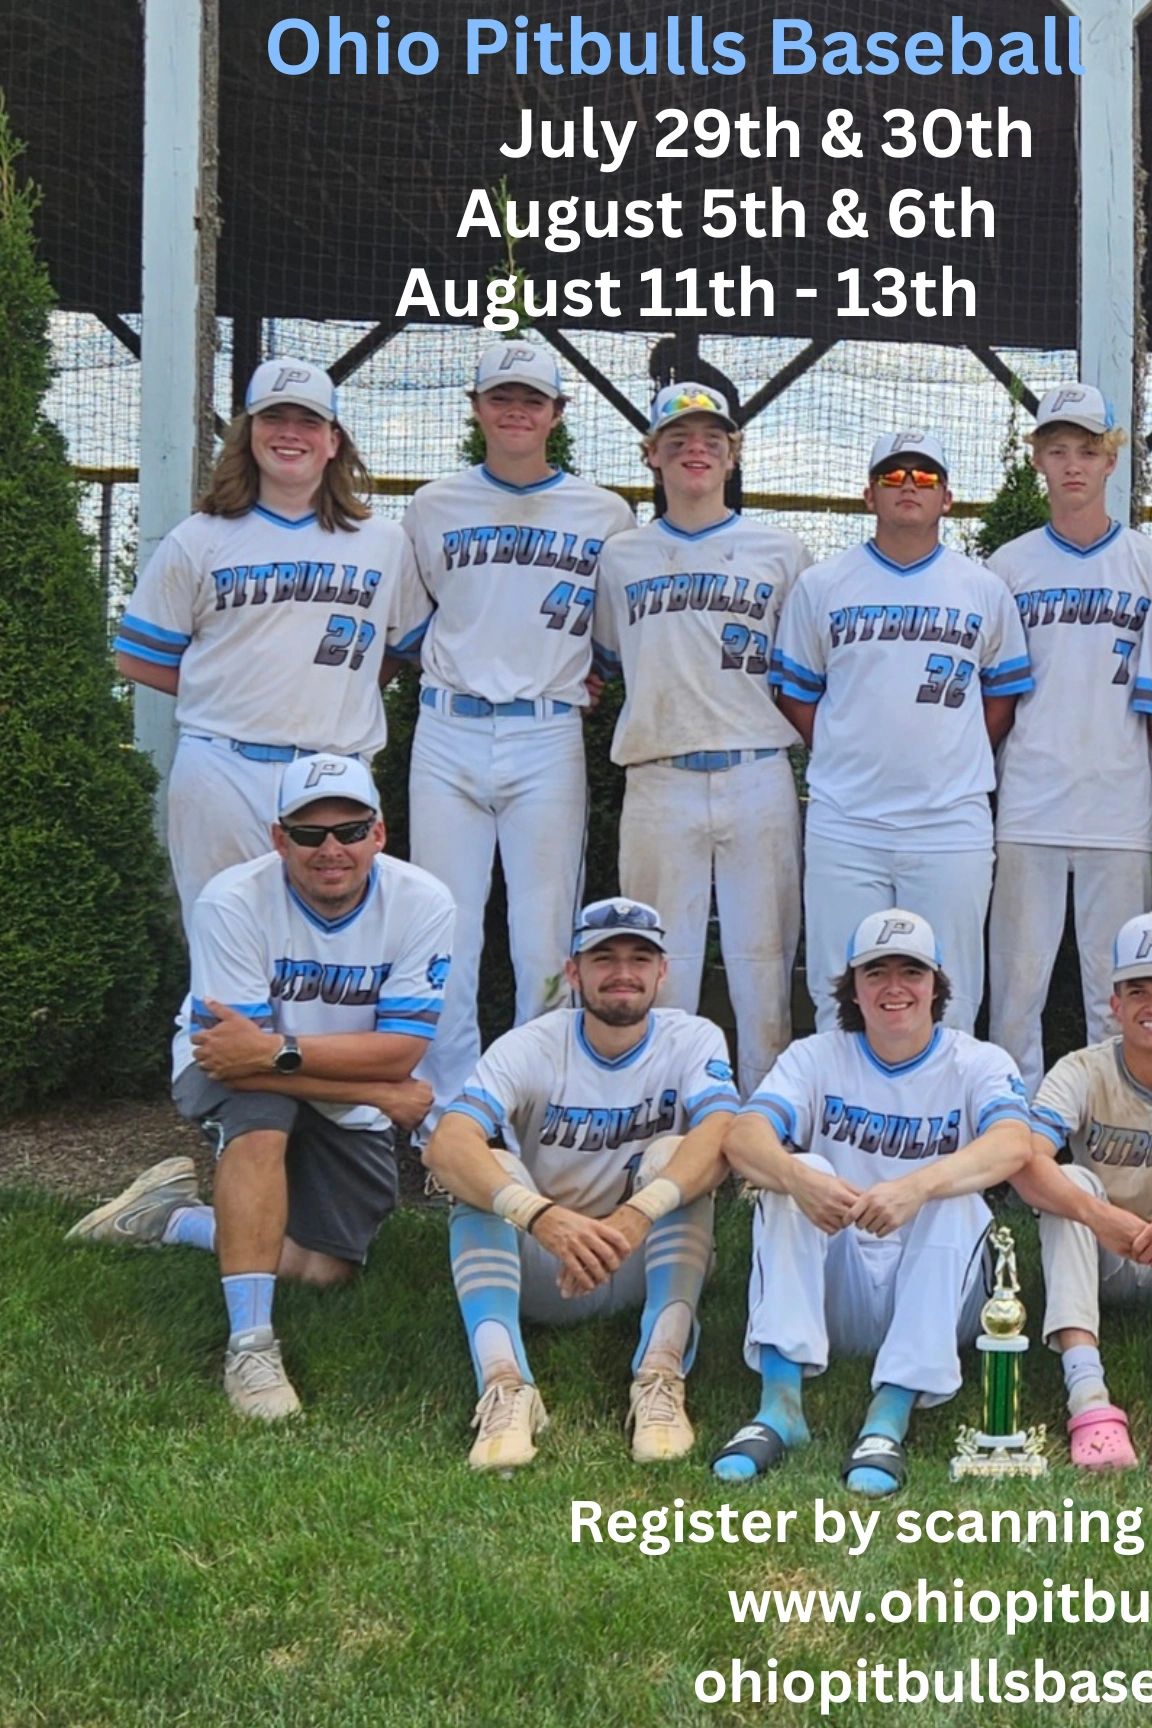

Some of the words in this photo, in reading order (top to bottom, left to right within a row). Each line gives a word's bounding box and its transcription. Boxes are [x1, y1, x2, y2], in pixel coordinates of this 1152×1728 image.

[272, 368, 312, 392] P
[499, 348, 536, 371] P
[1051, 390, 1086, 412] P
[442, 525, 604, 577] PITBULLS
[211, 560, 382, 611] PITBULLS
[624, 572, 774, 626] PITBULLS
[540, 581, 598, 637] 47
[829, 605, 982, 650] PITBULLS
[1014, 587, 1152, 631] PITBULLS
[721, 622, 769, 675] 23
[1112, 638, 1137, 685] 7
[916, 653, 976, 709] 32
[304, 761, 348, 789] P
[876, 919, 915, 945] P
